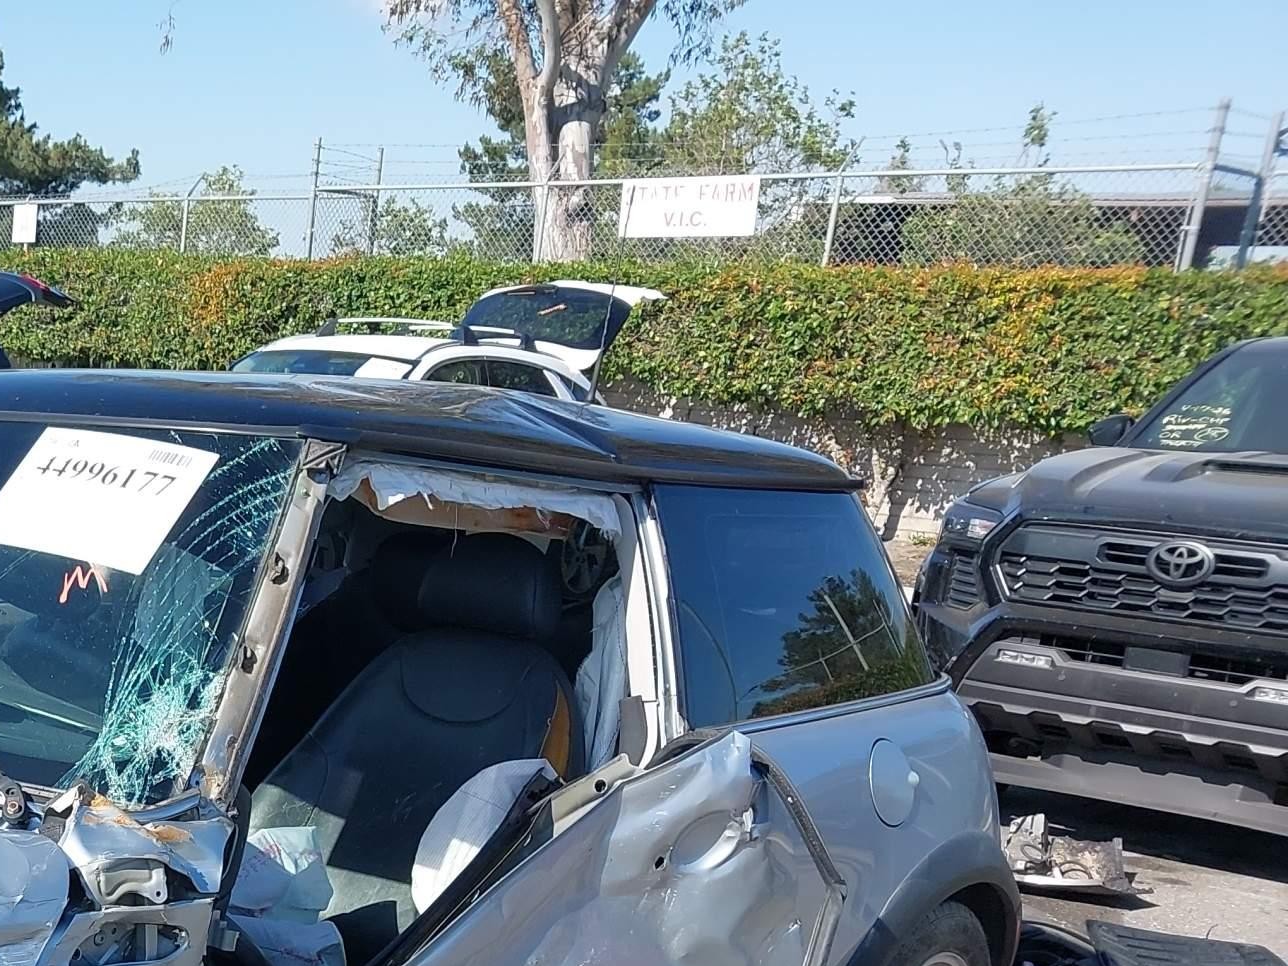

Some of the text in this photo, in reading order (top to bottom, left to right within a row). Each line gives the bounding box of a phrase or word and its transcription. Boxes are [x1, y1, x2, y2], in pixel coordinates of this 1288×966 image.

[699, 182, 755, 202] FARM
[664, 211, 707, 227] V.I.C.
[36, 456, 177, 496] 44996177
